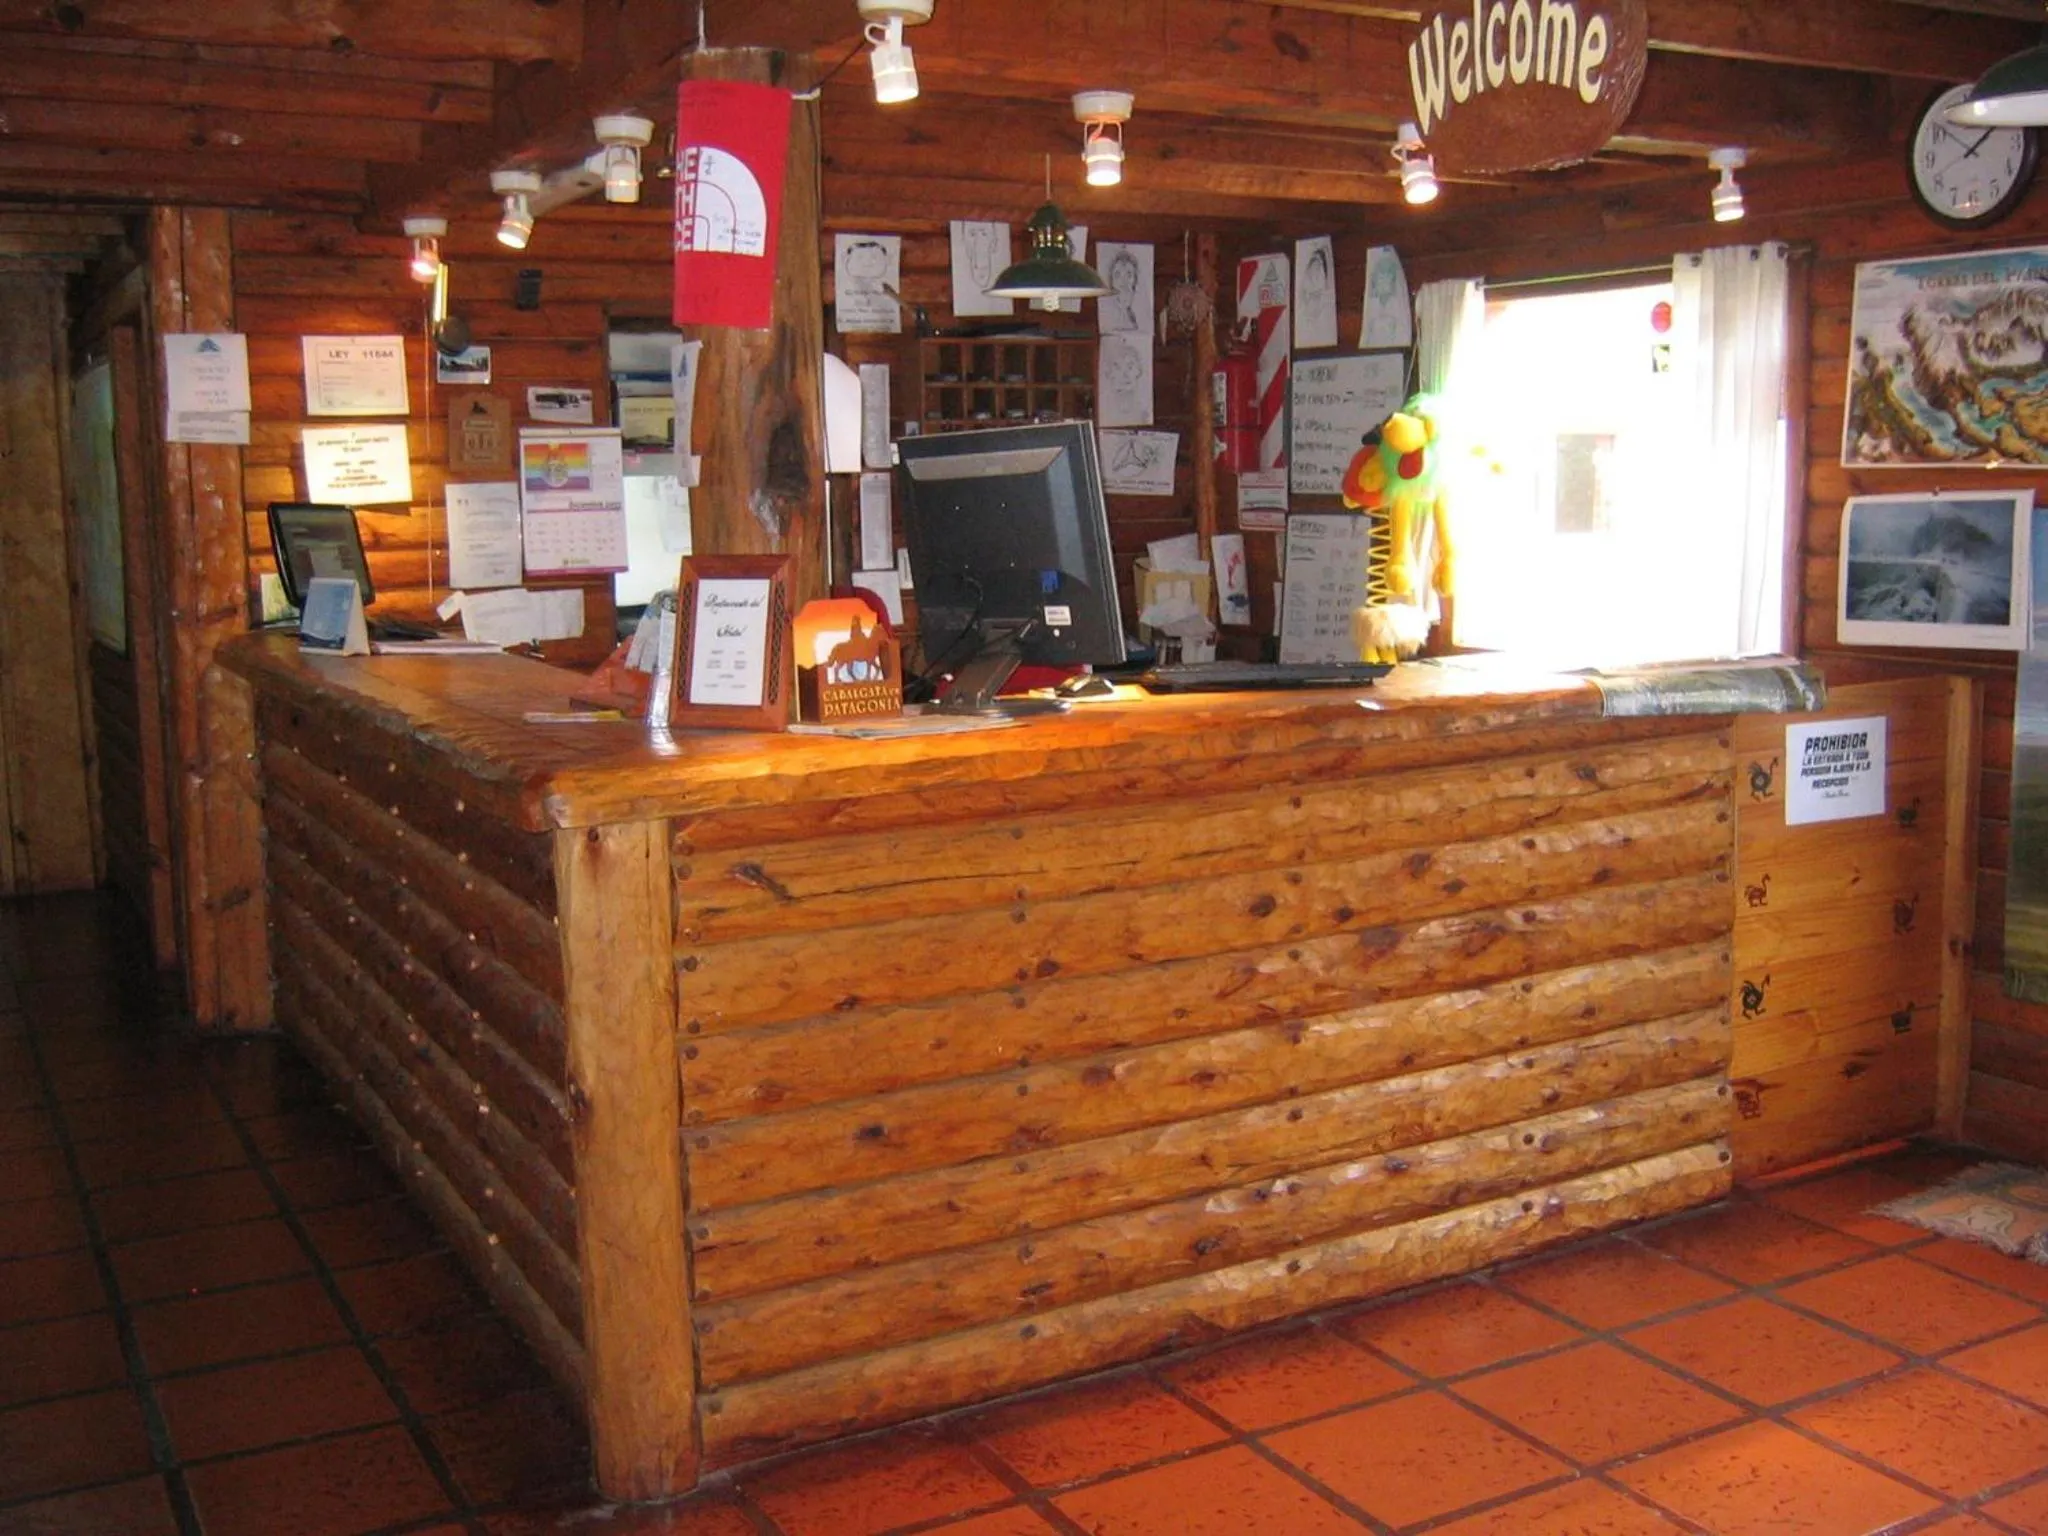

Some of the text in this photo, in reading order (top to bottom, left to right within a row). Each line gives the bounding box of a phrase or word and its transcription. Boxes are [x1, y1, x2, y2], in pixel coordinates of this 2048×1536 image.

[1408, 0, 1608, 136] Welcome
[328, 350, 349, 359] LEY
[823, 685, 888, 702] CABALGATA
[824, 698, 901, 717] PATAGONIA
[1804, 733, 1868, 754] PROHIBIDA
